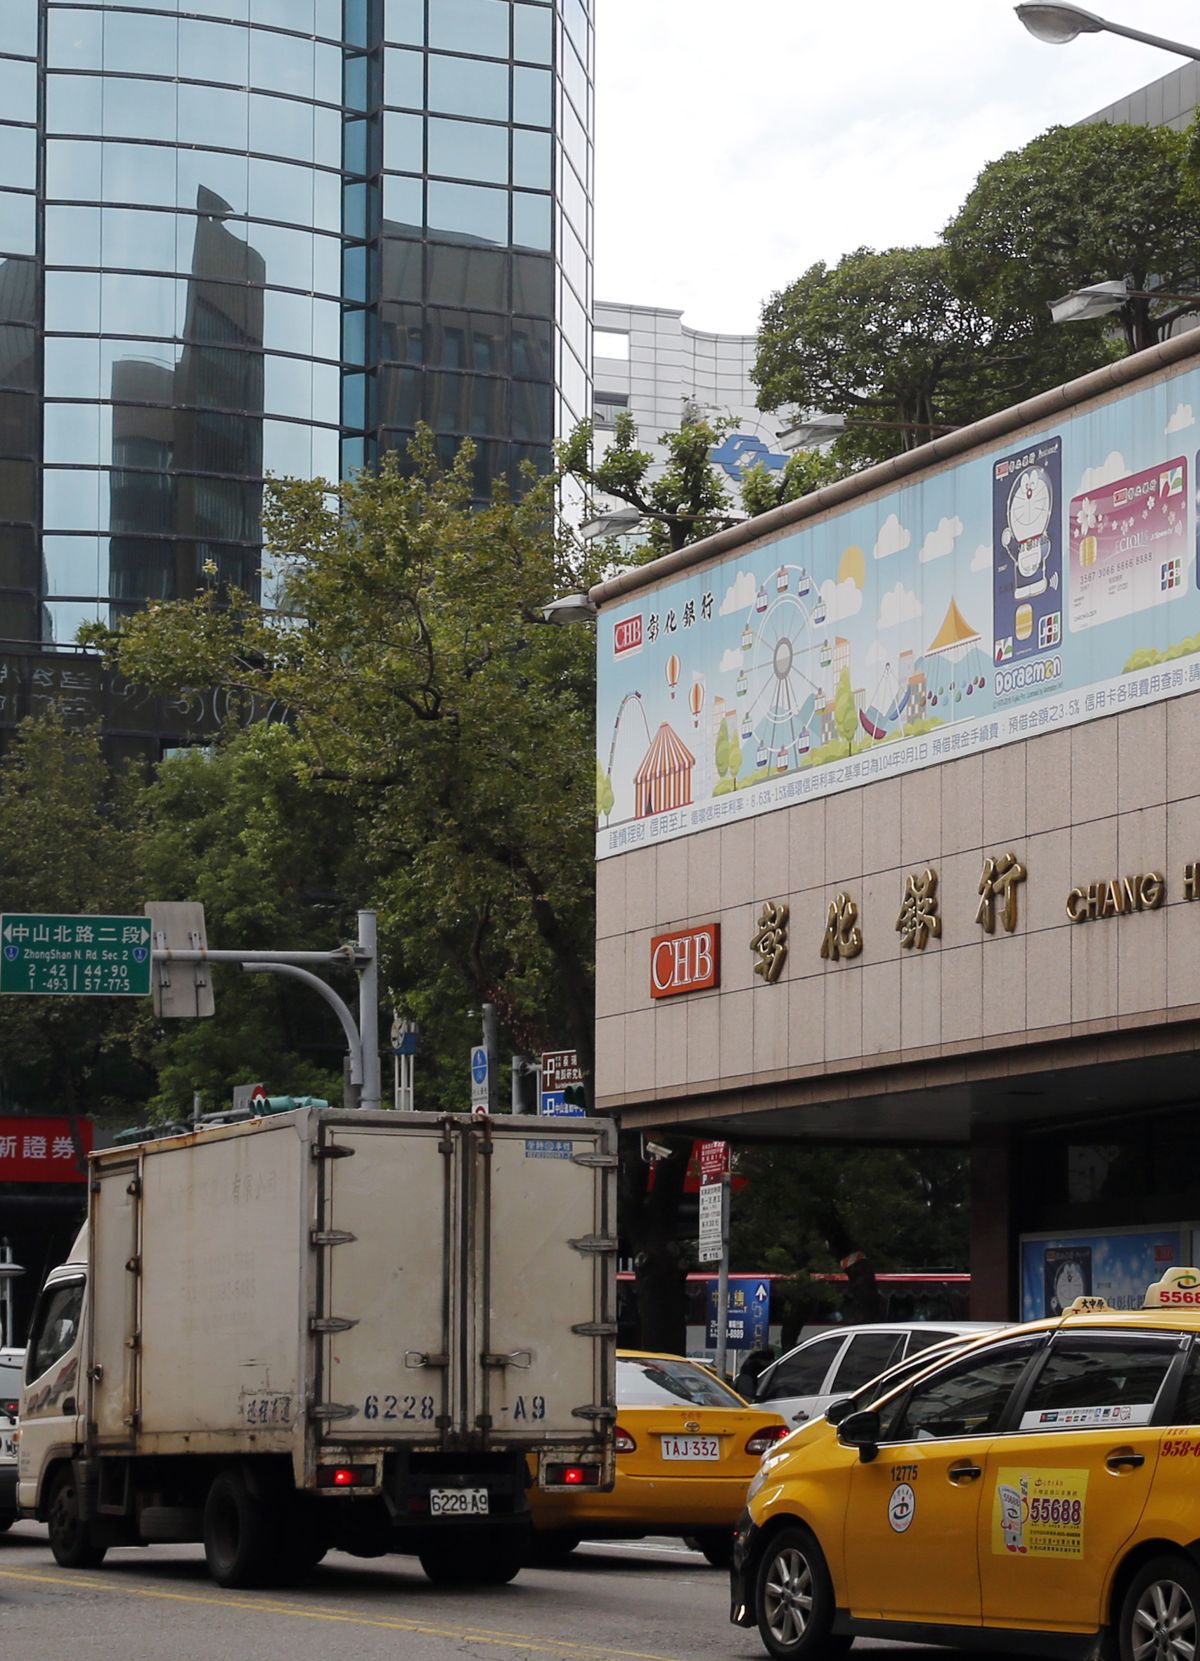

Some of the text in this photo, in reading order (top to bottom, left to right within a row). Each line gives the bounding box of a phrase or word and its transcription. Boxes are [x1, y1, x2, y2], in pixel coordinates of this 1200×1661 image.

[647, 592, 714, 642] 彰化銀行
[616, 621, 641, 649] CHB
[994, 655, 1062, 697] Doraemon
[650, 812, 687, 836] 信用至上
[1066, 872, 1165, 922] CHANG
[750, 852, 1027, 983] 彰化銀行
[12, 923, 141, 944] 中山北路二段
[652, 931, 712, 990] CHB
[364, 1395, 434, 1420] 6228
[664, 1440, 718, 1456] TAJ-332
[891, 1464, 919, 1481] 12775
[431, 1494, 488, 1514] 6228-A9
[1030, 1498, 1081, 1525] 55688
